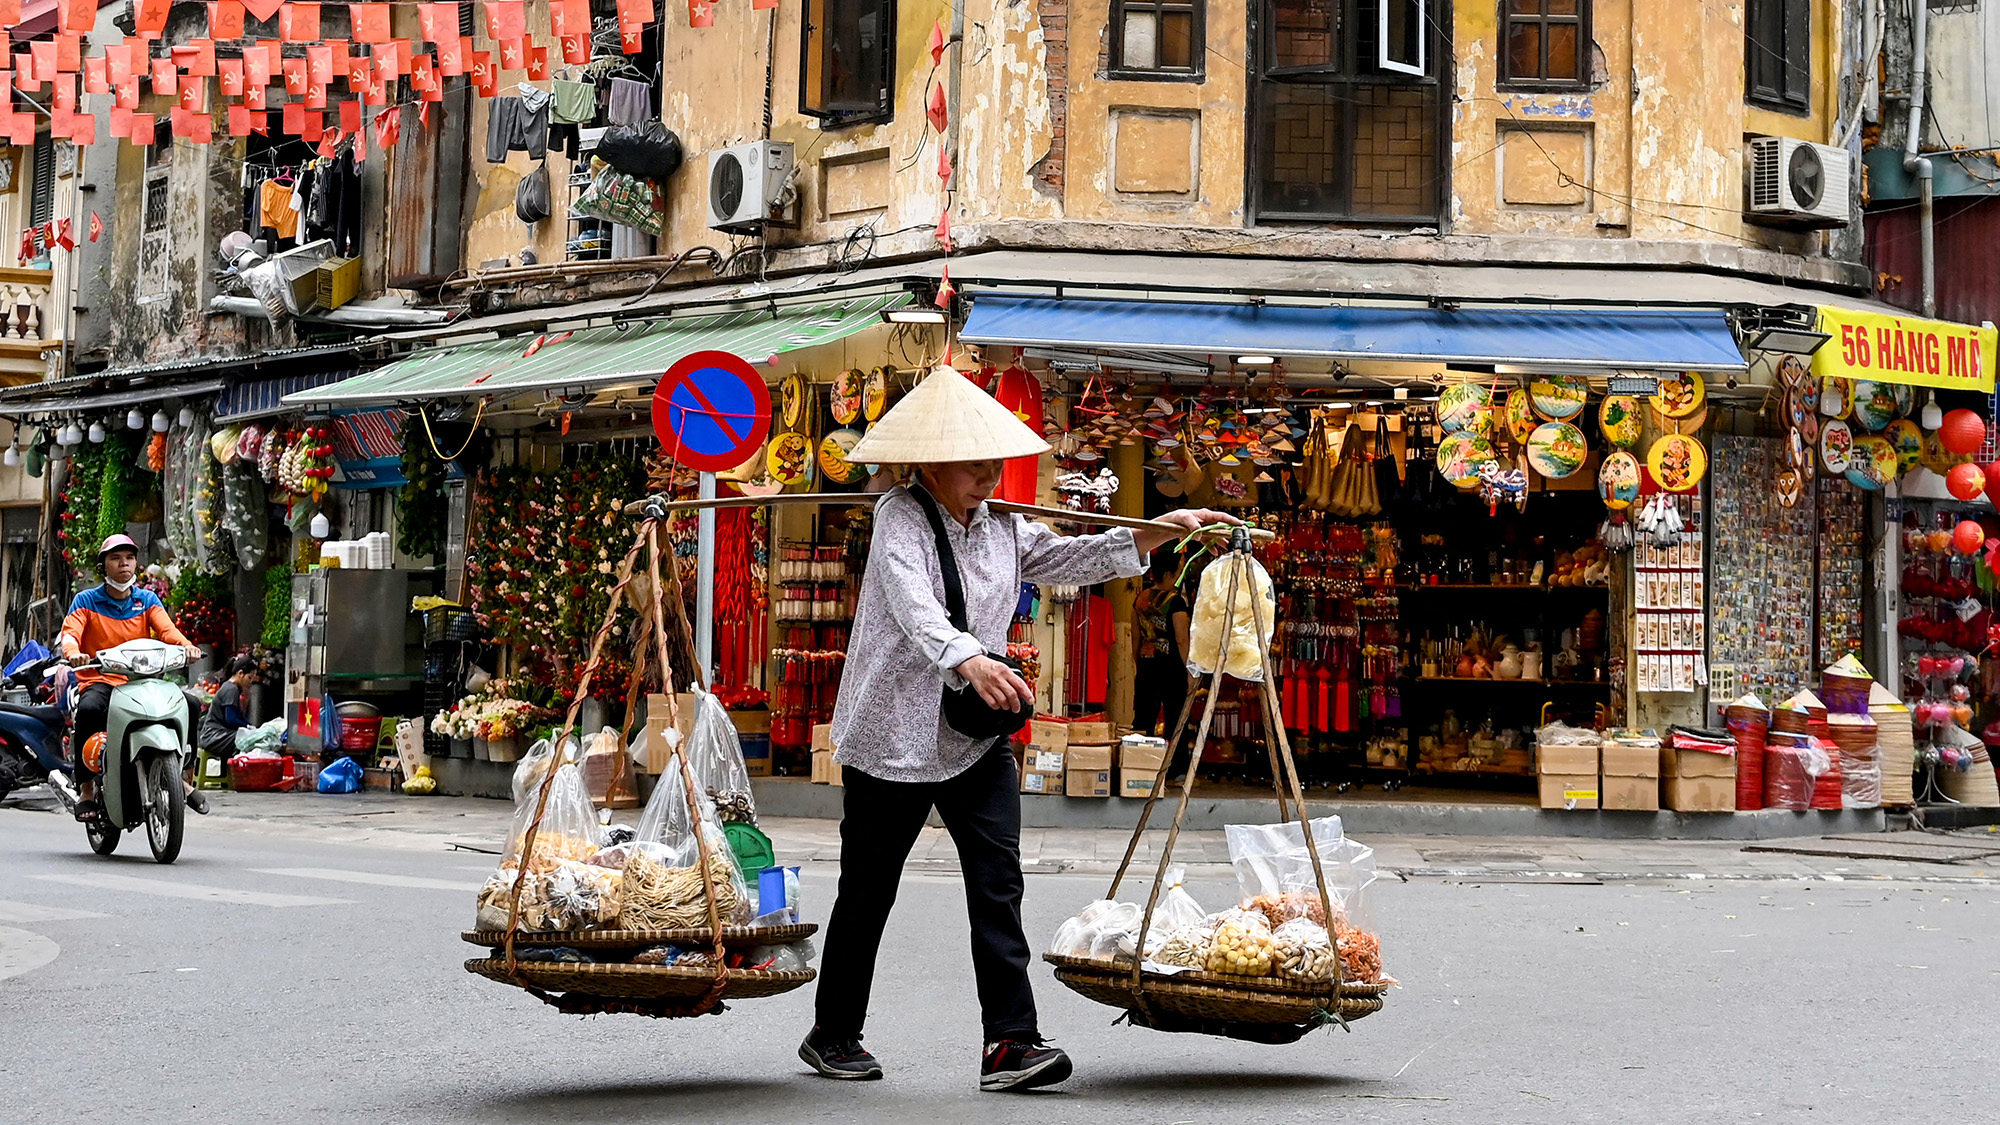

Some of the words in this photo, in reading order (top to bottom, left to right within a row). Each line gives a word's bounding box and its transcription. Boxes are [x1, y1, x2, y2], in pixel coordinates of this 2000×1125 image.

[1841, 324, 1870, 367] 56
[1876, 320, 1940, 375] HÀNG
[1946, 330, 1982, 379] MÃ
